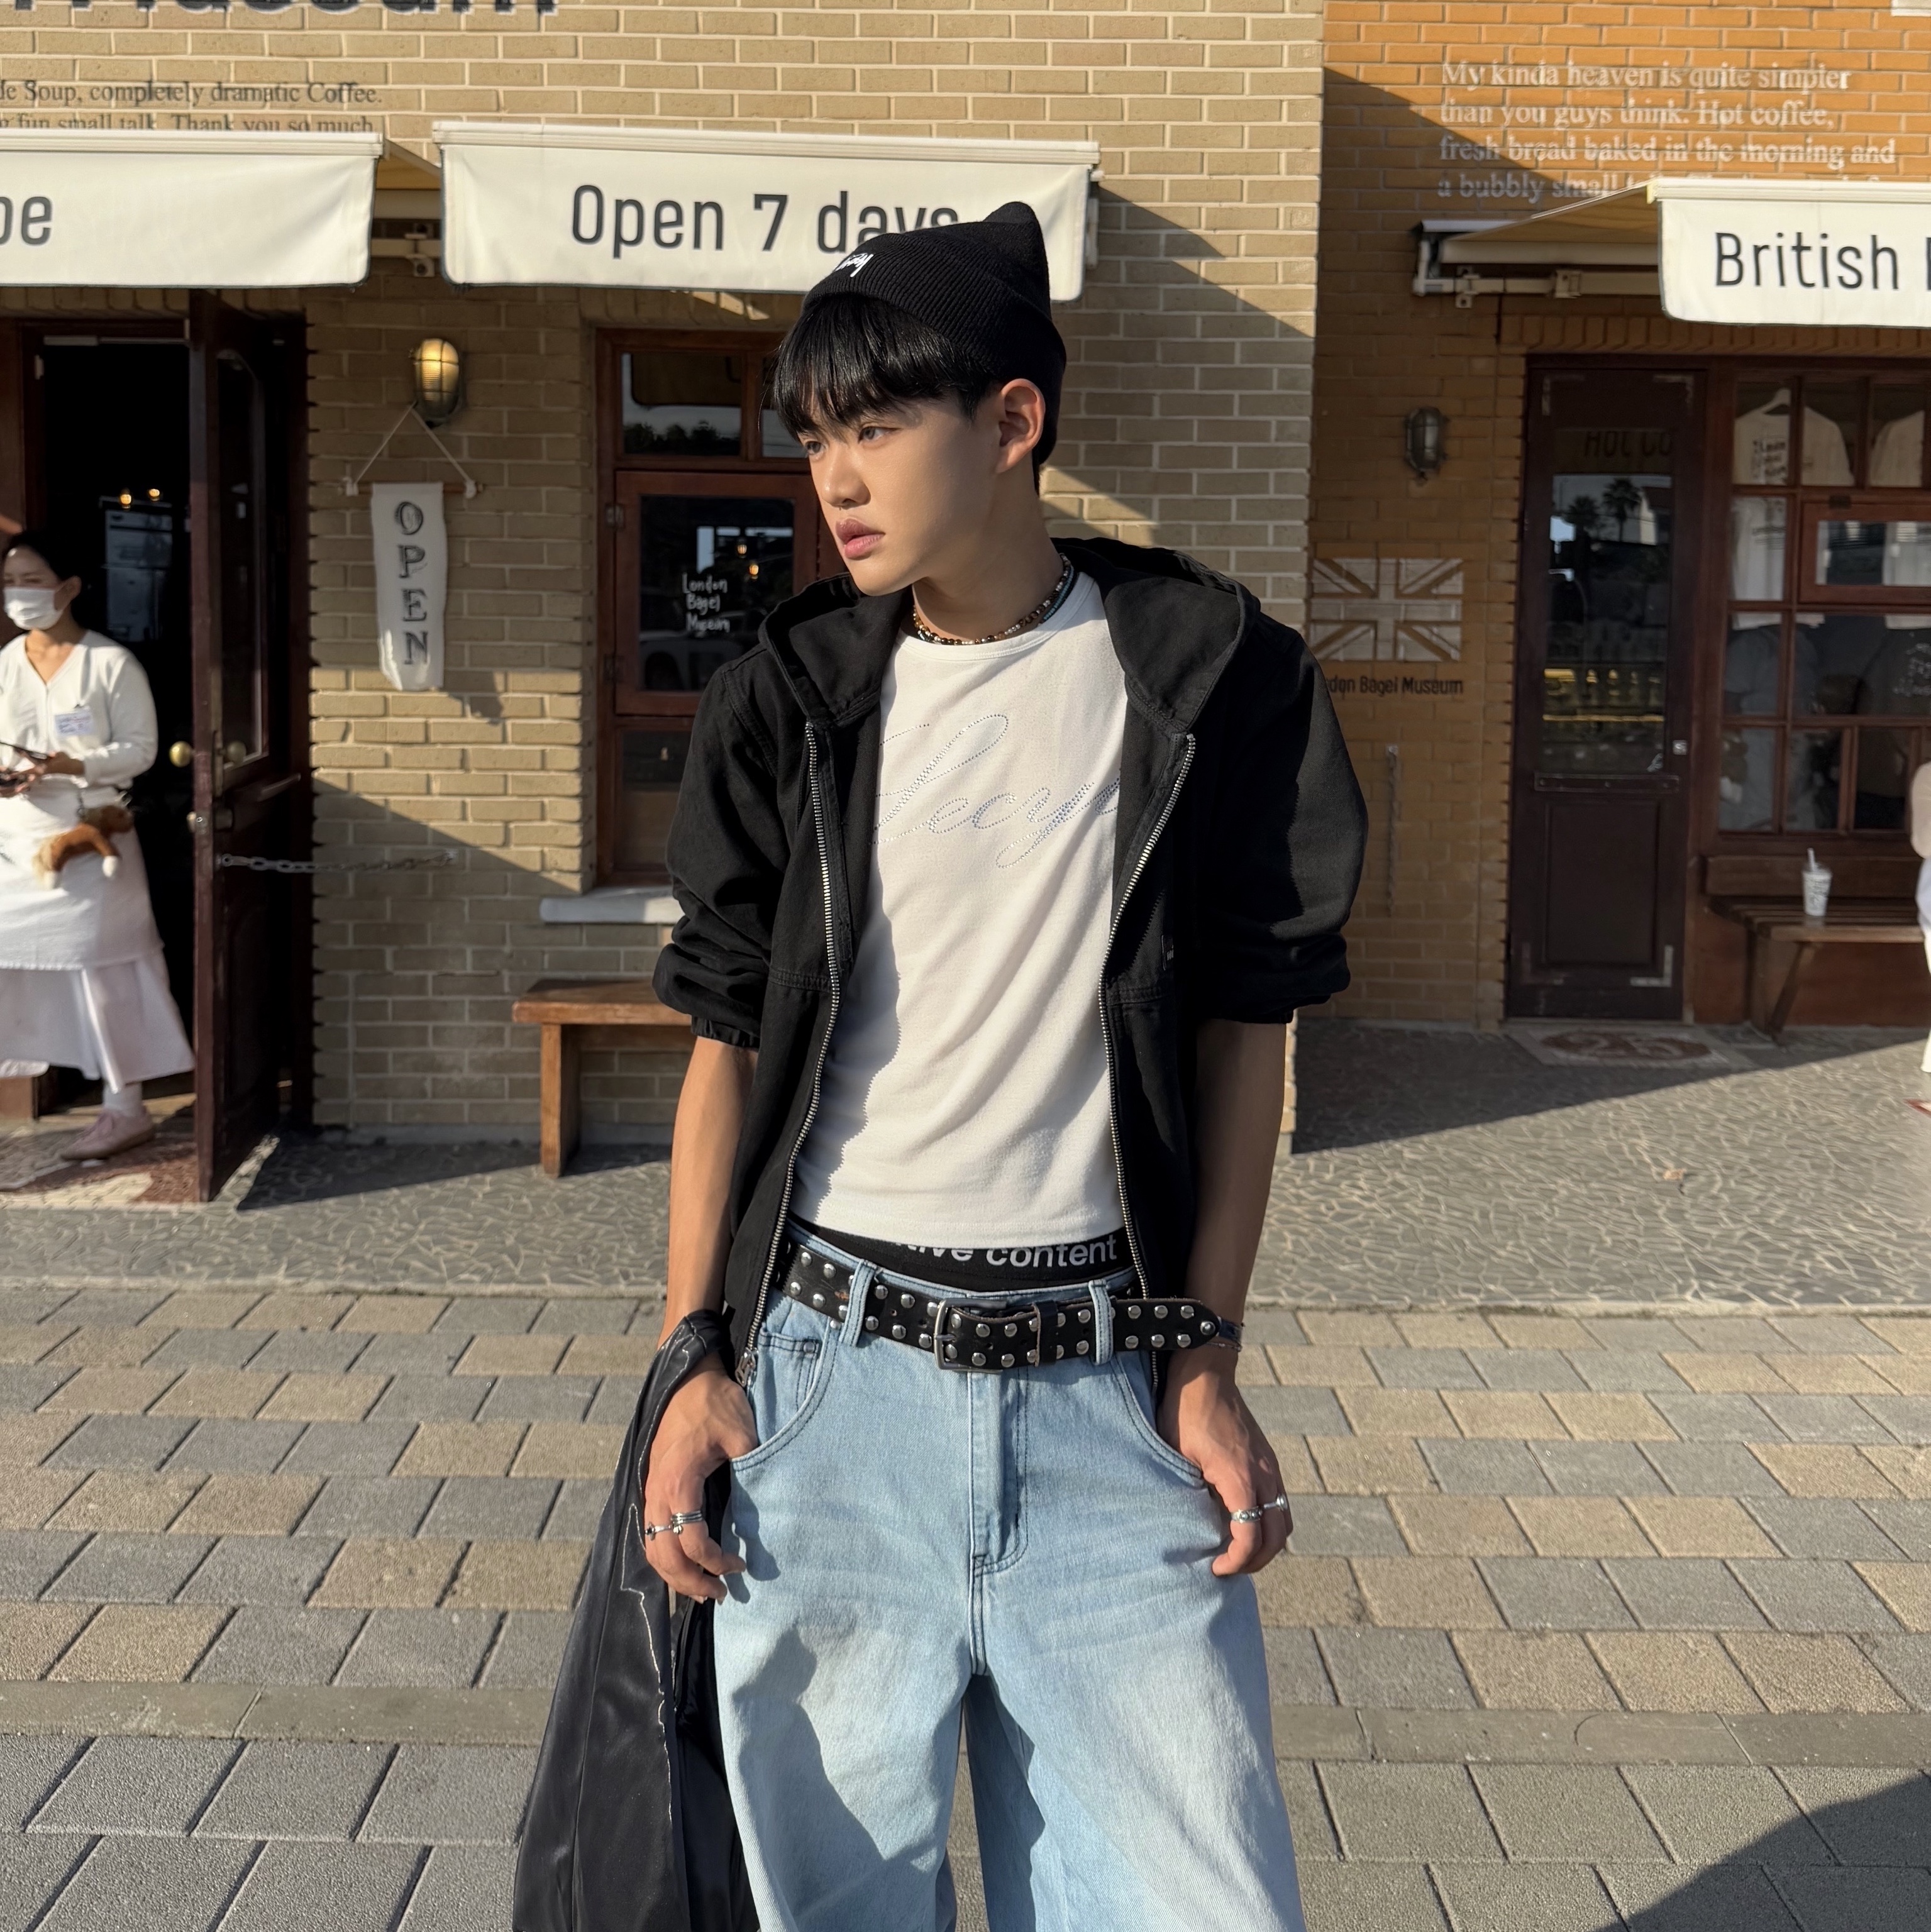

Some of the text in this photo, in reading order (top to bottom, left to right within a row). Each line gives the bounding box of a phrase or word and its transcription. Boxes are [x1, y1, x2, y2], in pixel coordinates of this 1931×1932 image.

[1442, 58, 1851, 95] My kinda heaven is quite simpler
[25, 80, 82, 106] Soup,
[91, 80, 203, 107] completely
[211, 81, 300, 102] dramatic
[307, 82, 382, 102] Coffee.
[18, 112, 50, 130] fun
[58, 114, 112, 130] small
[170, 114, 233, 130] Thank
[243, 119, 280, 131] you
[287, 119, 310, 131] so
[1440, 97, 1835, 130] than you guys think. Hot coffee,
[1439, 134, 1896, 170] fresh bread baked in the morning and
[1437, 177, 1451, 197] a
[1459, 171, 1546, 204] bubbly
[1552, 173, 1618, 197] small
[572, 184, 724, 259] Open
[753, 193, 788, 251] 7
[1715, 231, 1899, 290] British
[394, 501, 428, 665] OPEN
[682, 571, 728, 594] London
[686, 592, 721, 615] Bagel
[1359, 675, 1398, 697] Bagel
[1402, 676, 1464, 694] Museum
[986, 1234, 1117, 1267] content
